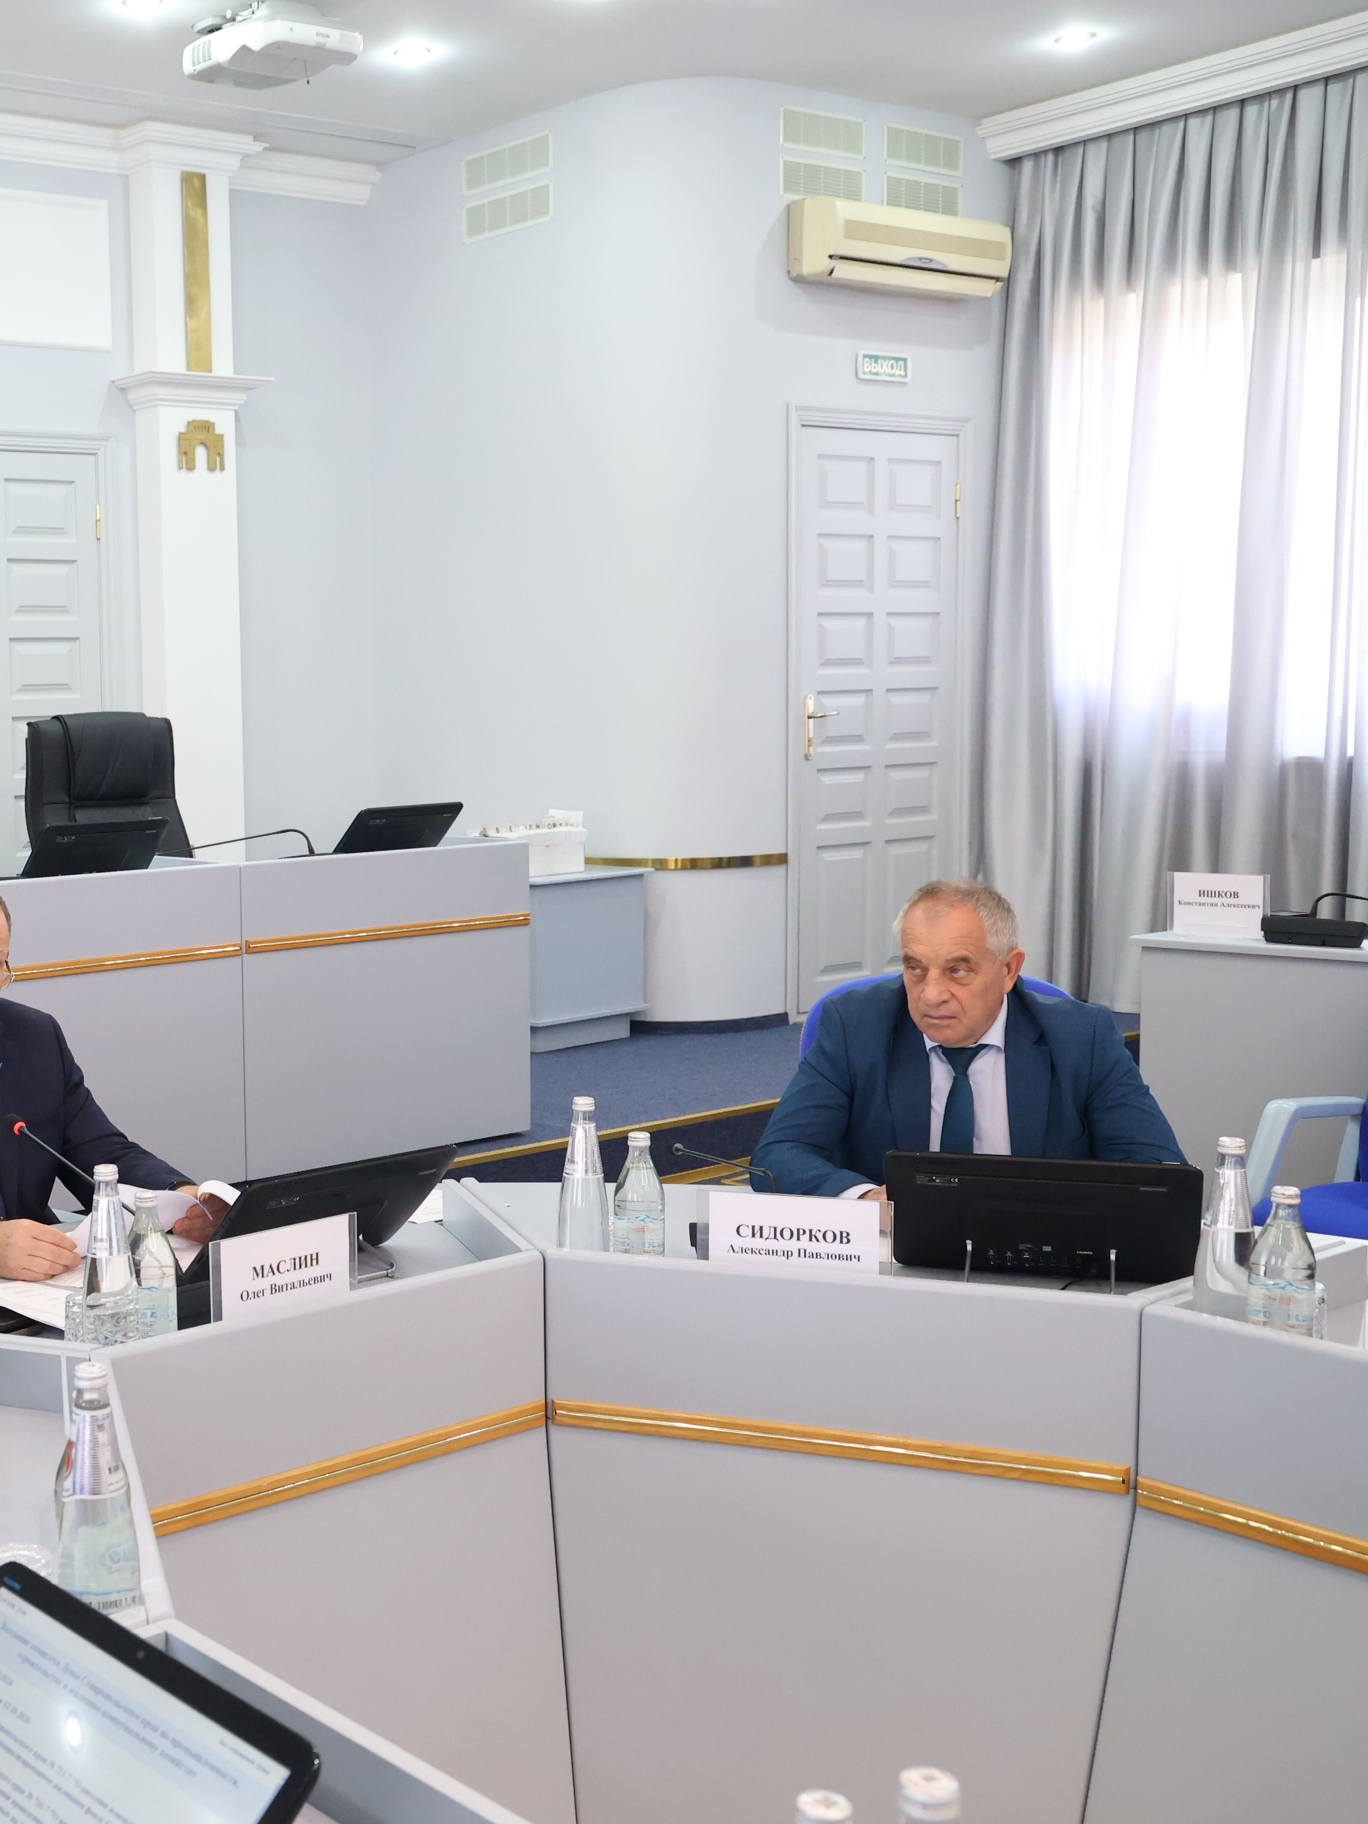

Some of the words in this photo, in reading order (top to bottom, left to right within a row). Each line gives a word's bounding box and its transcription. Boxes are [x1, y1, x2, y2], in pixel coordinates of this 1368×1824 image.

[864, 357, 906, 376] ВЫХОД
[1198, 889, 1240, 899] ИШКОВ
[1178, 899, 1218, 907] Константин
[1220, 901, 1261, 910] Алексеевич
[735, 1223, 852, 1245] СИДОРКОВ
[727, 1243, 794, 1260] Александр
[797, 1247, 861, 1263] Павлович
[251, 1252, 320, 1281] МАСЛИН
[240, 1287, 267, 1302] Олег
[269, 1272, 333, 1296] Витальевич
